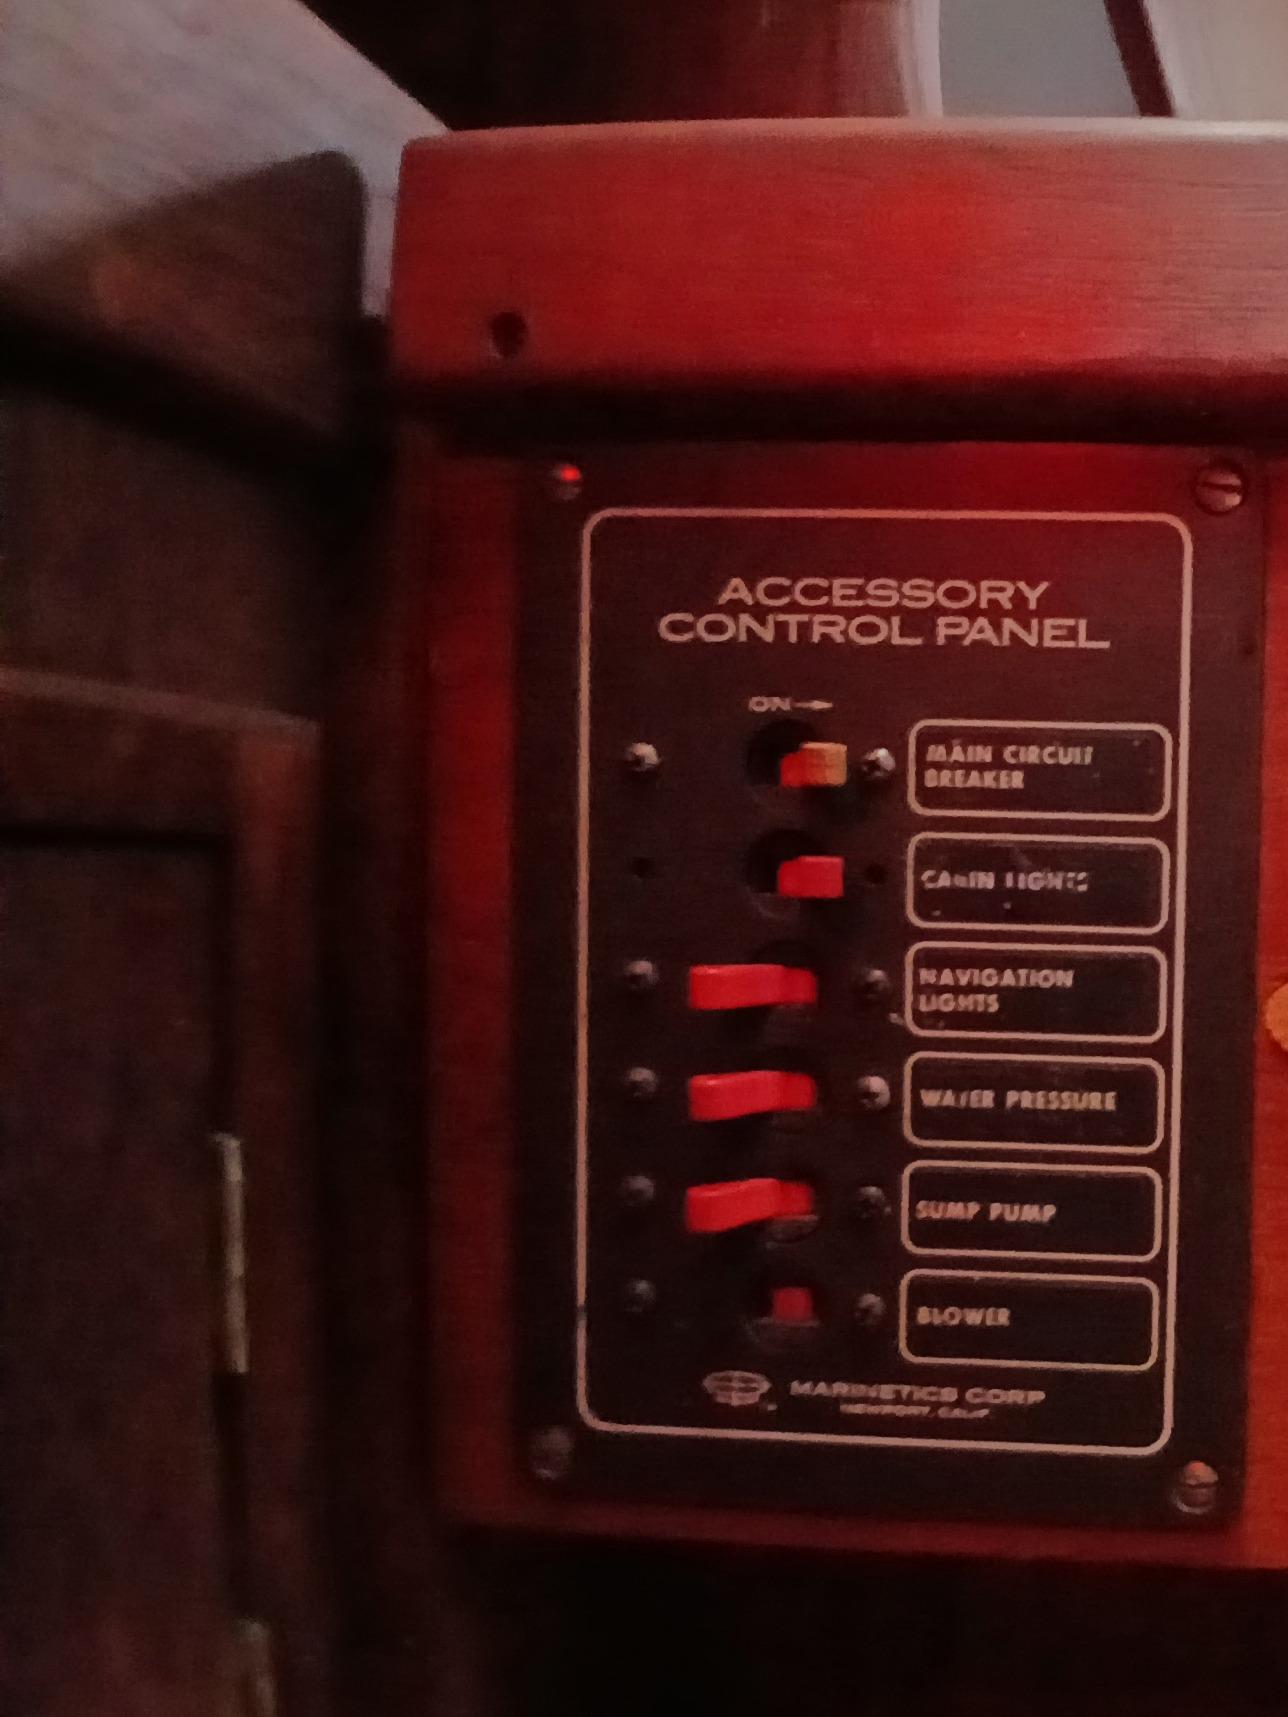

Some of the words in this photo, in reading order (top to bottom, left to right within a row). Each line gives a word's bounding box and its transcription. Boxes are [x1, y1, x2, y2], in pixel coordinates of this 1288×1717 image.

[717, 577, 1050, 609] ACCESSORY
[657, 612, 922, 645] CONTROL
[936, 616, 1112, 649] PANEL
[748, 696, 791, 712] ON
[925, 744, 992, 763] MAIN
[1003, 745, 1094, 765] CIRCUIT
[924, 769, 1025, 790] BREAKER
[919, 968, 1075, 988] NAVIGATION
[919, 993, 999, 1012] LIGHTS
[1006, 1090, 1117, 1111] PRESSURE
[915, 1200, 981, 1220] SUMP
[989, 1202, 1057, 1223] PUMP
[916, 1306, 1011, 1326] BLOWER
[790, 1380, 958, 1402] MARINETICS
[965, 1387, 1046, 1405] CORP
